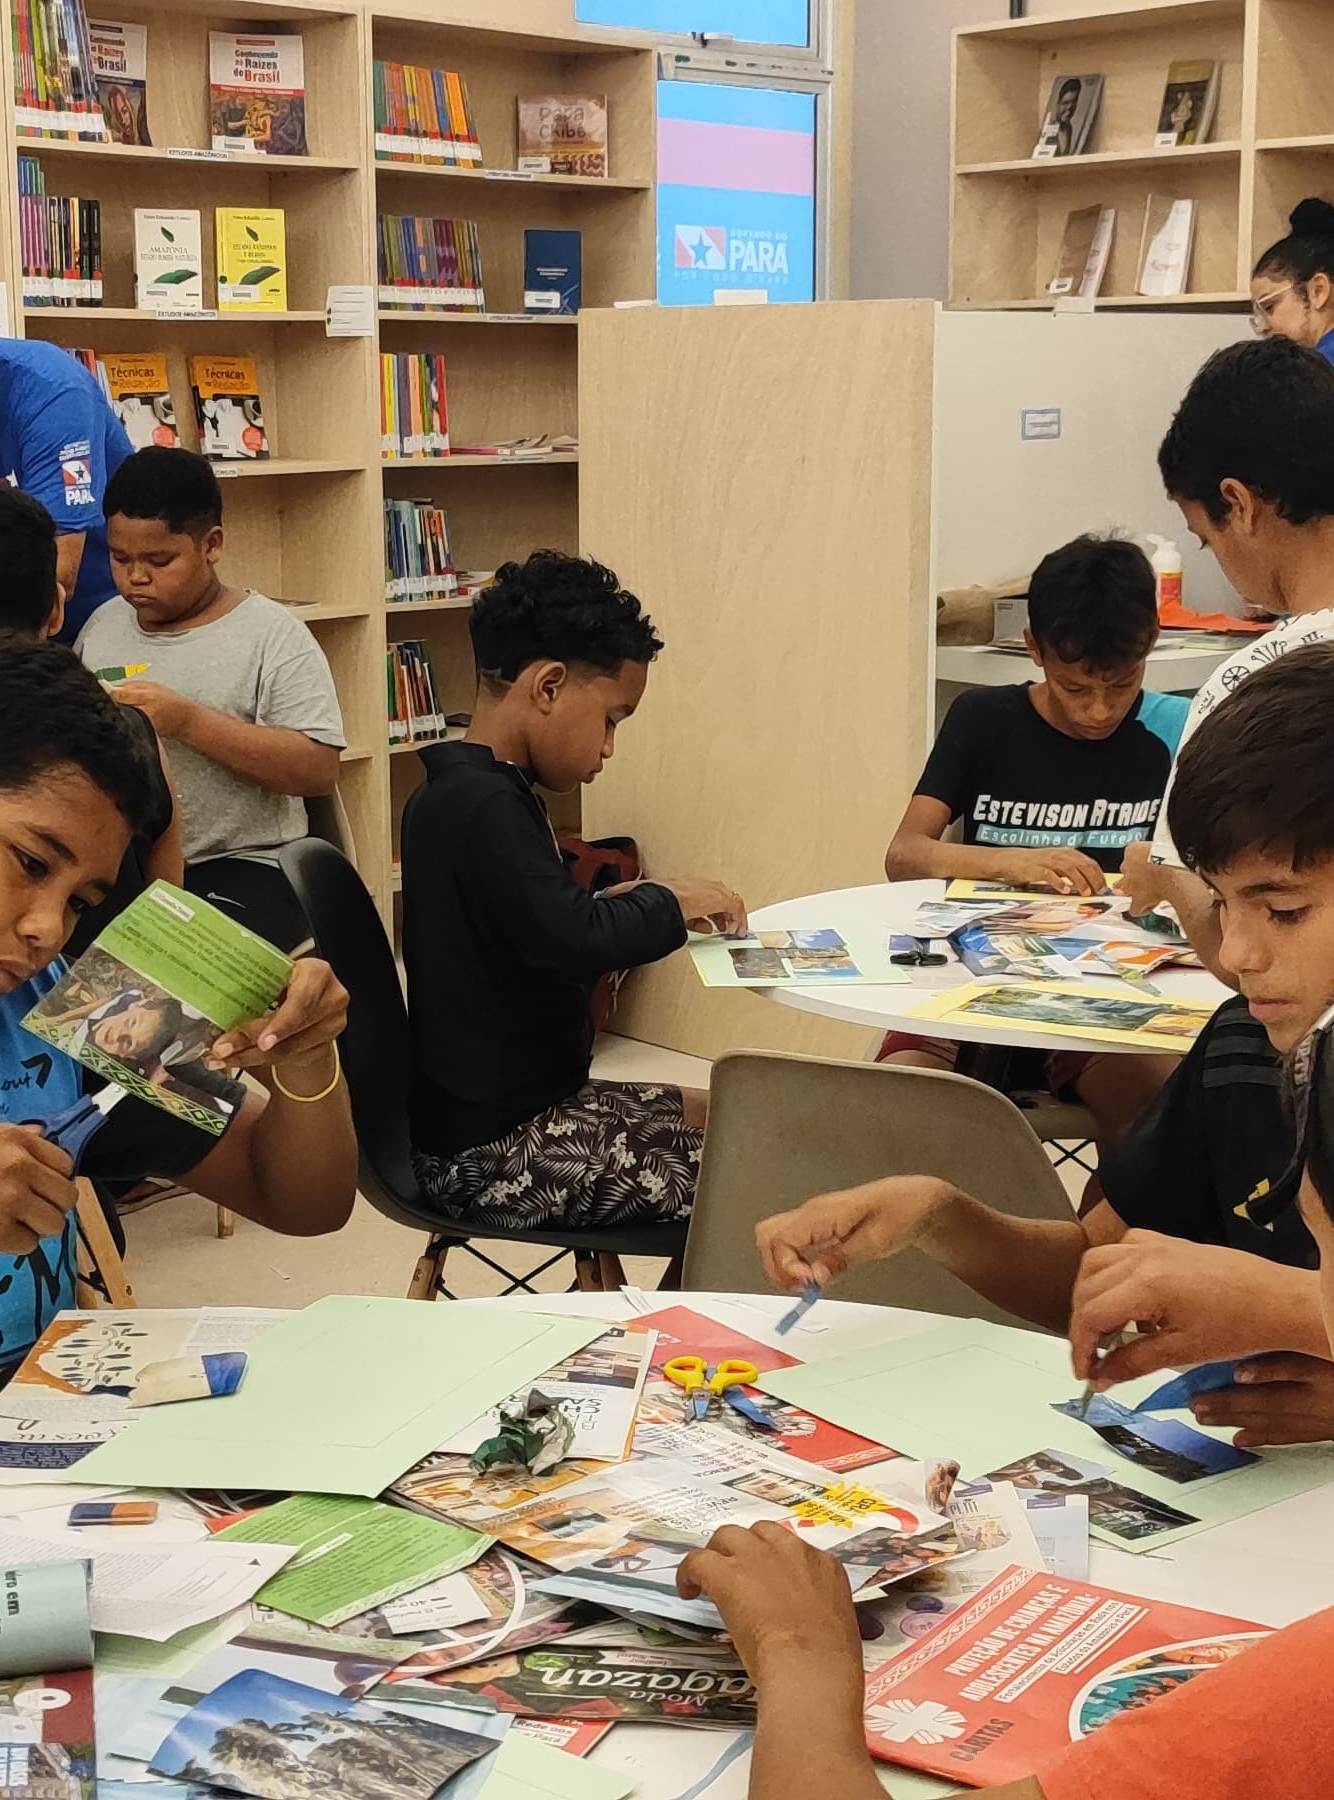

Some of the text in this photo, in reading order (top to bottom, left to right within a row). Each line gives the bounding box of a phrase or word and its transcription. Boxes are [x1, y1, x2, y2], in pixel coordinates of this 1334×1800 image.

[97, 56, 127, 73] Brasil
[244, 69, 281, 83] Brasil
[111, 366, 155, 378] Técnicas
[205, 367, 246, 380] Técnicas
[973, 794, 1090, 828] ESTEVISON
[980, 827, 1066, 846] Escolinha
[6, 1588, 21, 1617] em
[945, 1582, 1069, 1677] PROTEÇÃO DE CRIANÇAS E
[959, 1642, 1041, 1700] ADOLESCENTES
[1027, 1631, 1053, 1648] NA
[627, 1689, 709, 1707] Moda
[517, 1719, 548, 1730] Rede
